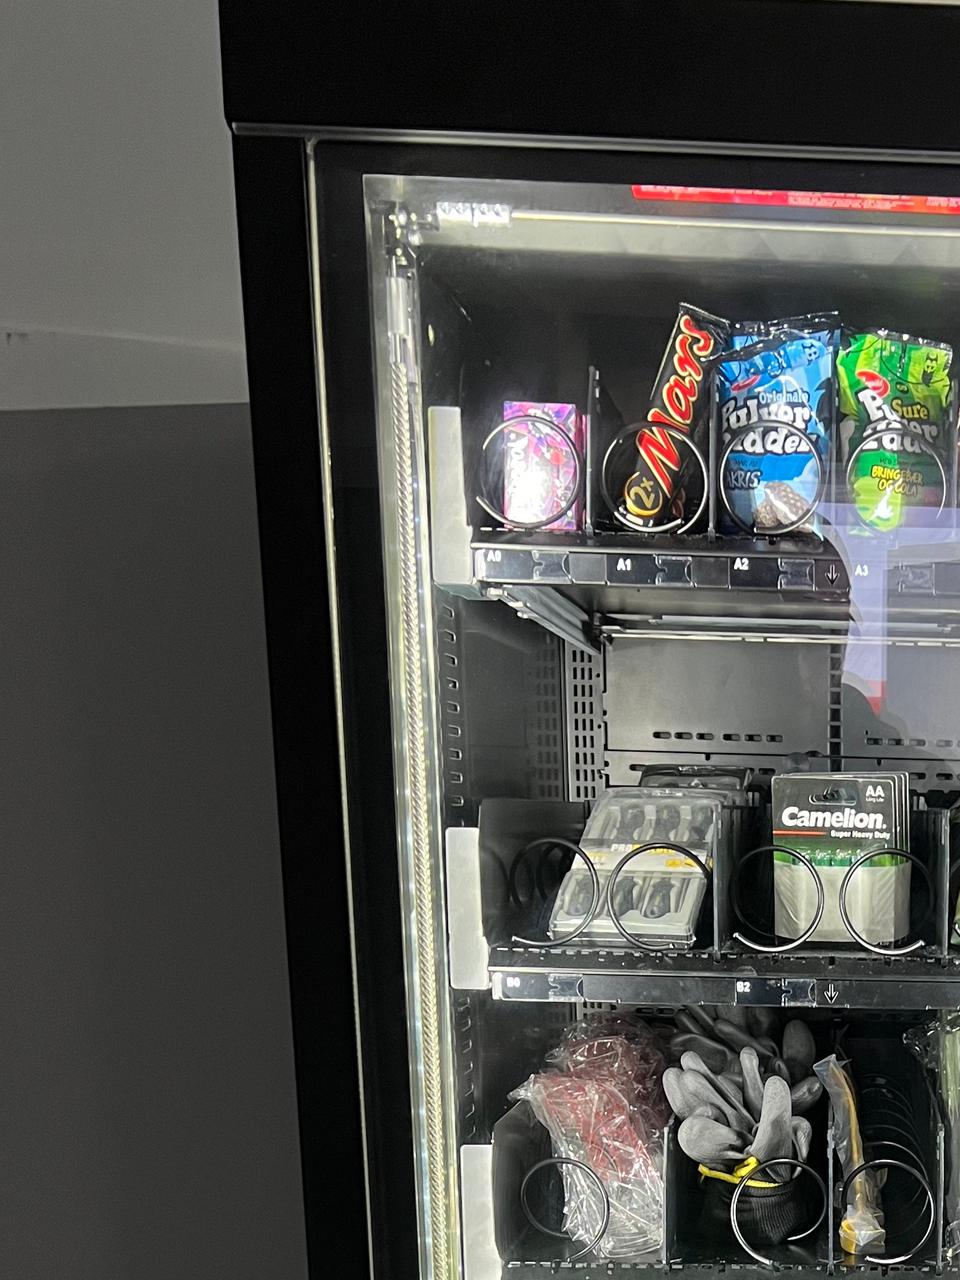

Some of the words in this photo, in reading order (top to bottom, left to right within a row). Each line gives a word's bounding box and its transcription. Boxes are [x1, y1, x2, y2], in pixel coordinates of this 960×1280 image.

[636, 314, 714, 500] Mars
[891, 398, 929, 420] Sure
[487, 550, 502, 562] A0
[617, 559, 632, 571] A1
[734, 557, 749, 570] A2
[855, 564, 869, 577] A3
[866, 785, 885, 797] AA
[831, 830, 851, 839] Super
[852, 831, 873, 840] Heavy
[874, 831, 890, 840] Duty
[506, 977, 520, 988] B0
[736, 981, 750, 993] B2
